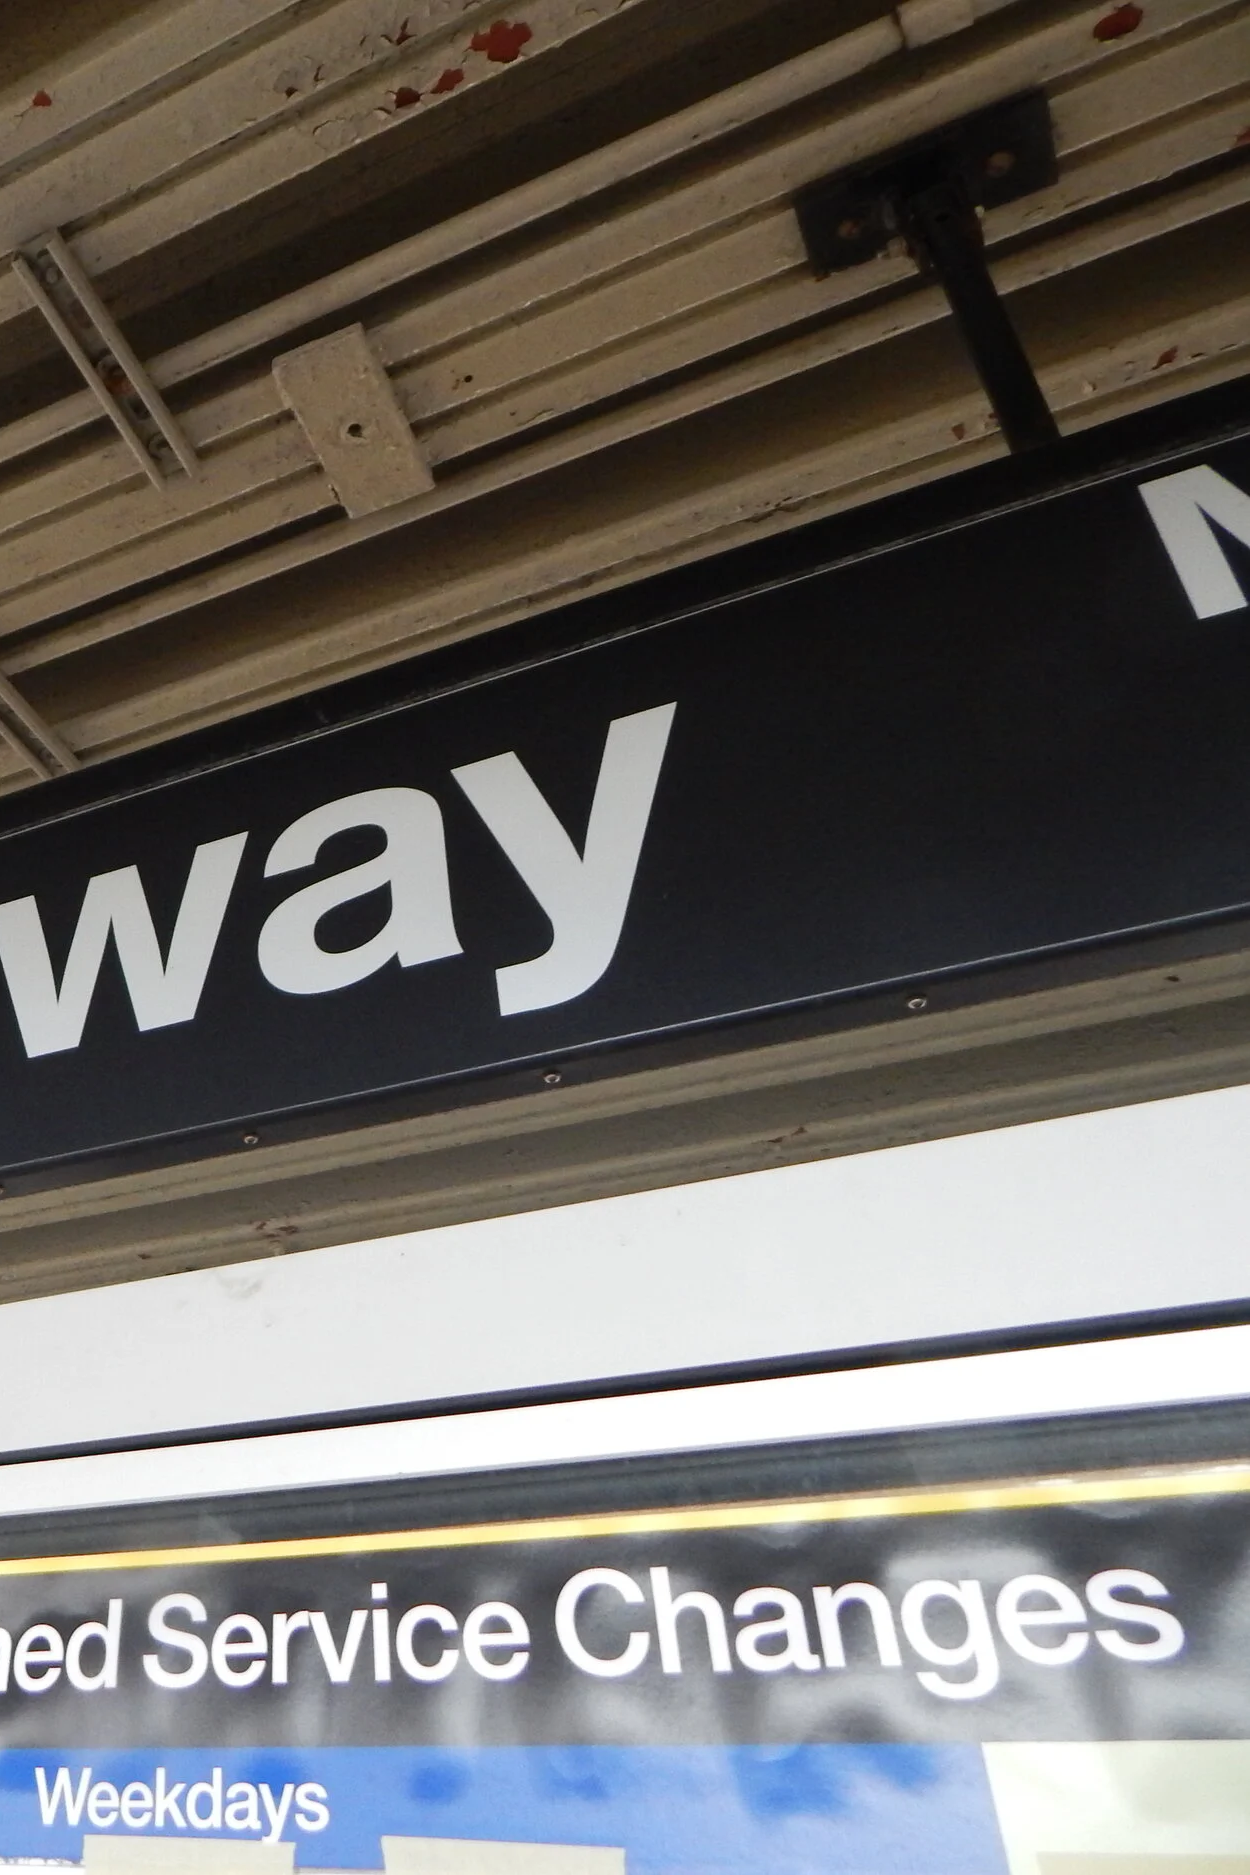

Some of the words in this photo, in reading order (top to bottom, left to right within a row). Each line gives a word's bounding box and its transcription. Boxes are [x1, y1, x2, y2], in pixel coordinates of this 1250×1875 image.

[143, 1582, 529, 1689] Service
[554, 1566, 1185, 1700] Changes
[35, 1767, 329, 1843] Weekdays
